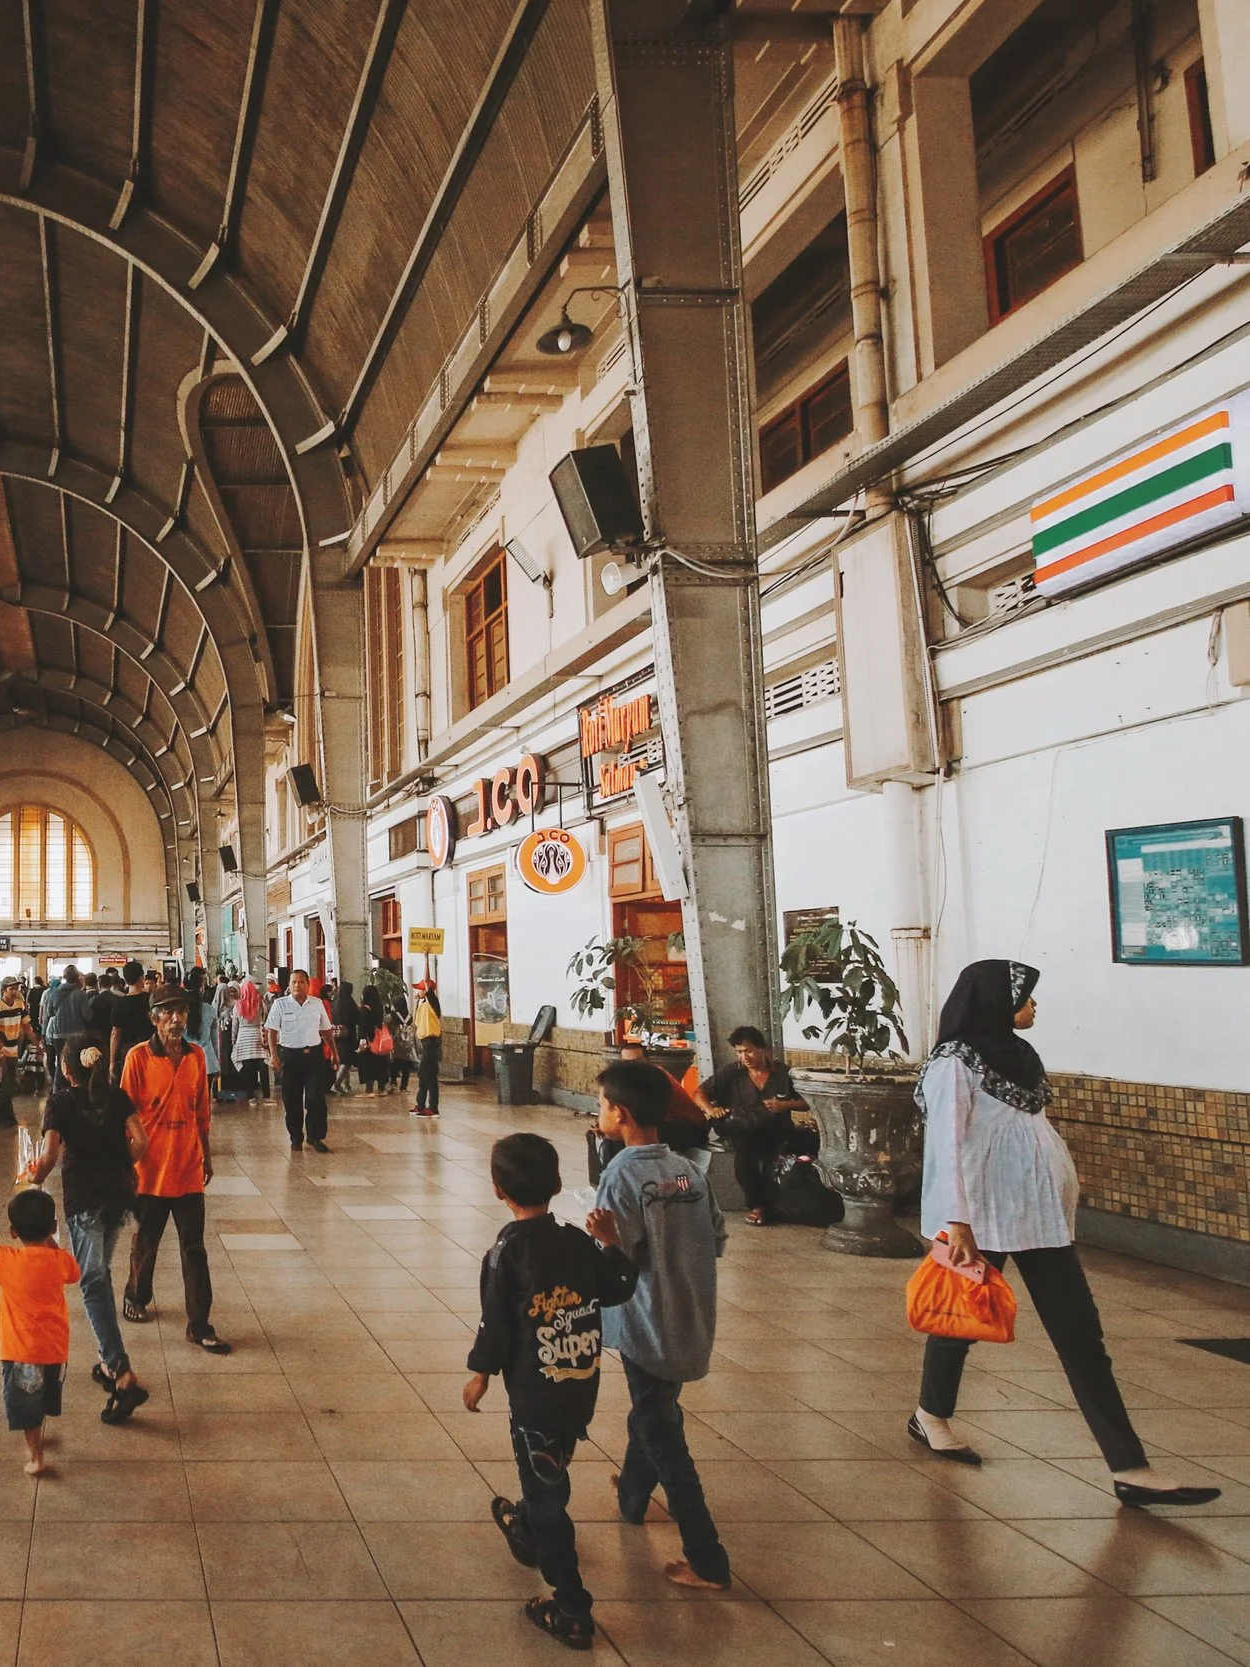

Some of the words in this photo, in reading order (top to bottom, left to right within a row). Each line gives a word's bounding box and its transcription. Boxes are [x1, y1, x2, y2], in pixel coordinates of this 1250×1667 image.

[467, 753, 543, 838] J.CO
[553, 1298, 599, 1333] Squad
[536, 1326, 600, 1368] Super
